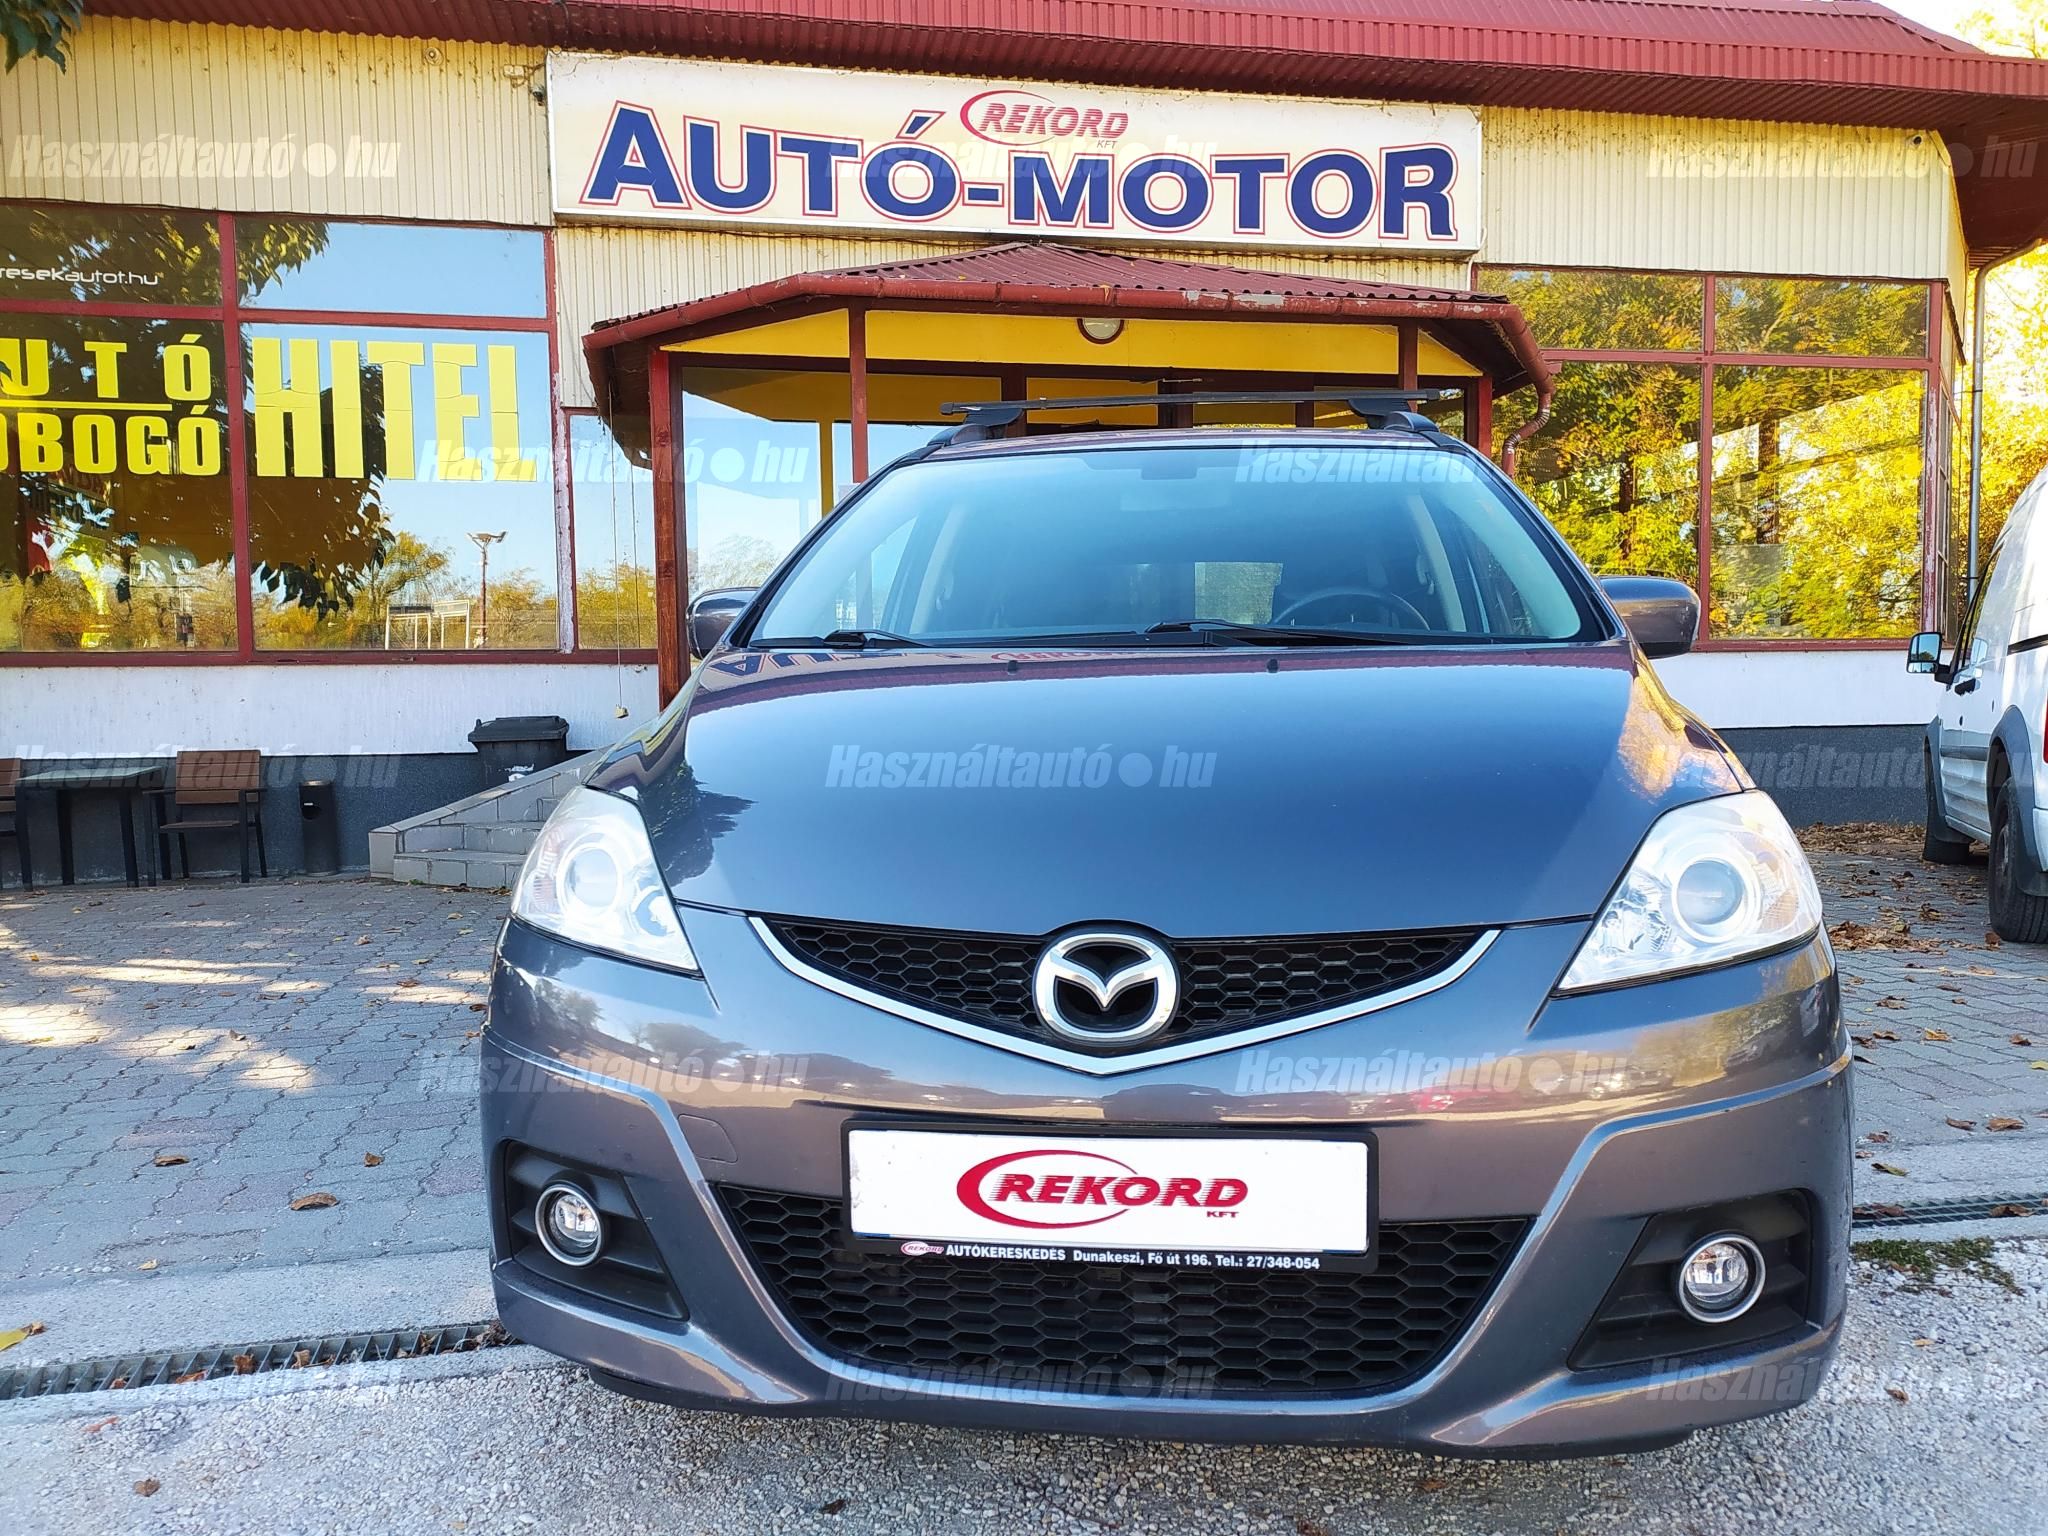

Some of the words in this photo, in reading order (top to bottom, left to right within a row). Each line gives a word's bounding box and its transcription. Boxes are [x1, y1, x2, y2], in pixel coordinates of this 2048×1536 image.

[980, 103, 1129, 138] REKORD
[1097, 140, 1118, 149] KFT
[580, 100, 1457, 241] AUTÓ-MOTOR
[252, 337, 537, 481] HITEL
[989, 1173, 1248, 1208] REKORD
[1206, 1211, 1239, 1219] KFT
[946, 1243, 1066, 1260] AUTÓKERESKEDÉS
[1073, 1250, 1144, 1266] Dunakeszi,
[1148, 1251, 1164, 1264] Fő
[1166, 1251, 1180, 1265] út
[1184, 1253, 1212, 1266] 196.
[1215, 1254, 1243, 1267] Tel.:
[1247, 1255, 1320, 1270] 27/348-054
